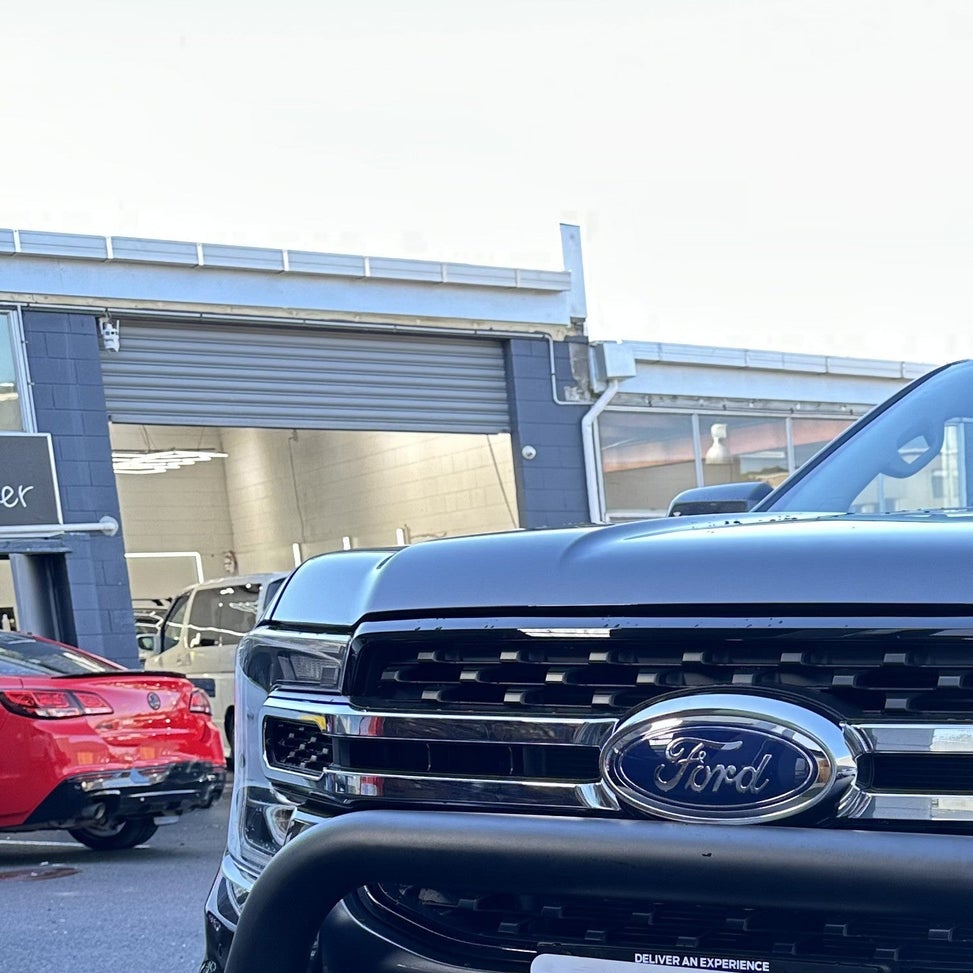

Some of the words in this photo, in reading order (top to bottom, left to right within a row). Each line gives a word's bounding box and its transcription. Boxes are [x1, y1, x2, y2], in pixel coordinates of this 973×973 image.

[0, 485, 34, 508] er
[654, 737, 773, 793] Ford
[634, 953, 680, 966] DELIVER
[681, 956, 698, 967] AN
[700, 957, 770, 972] EXPERIENCE
